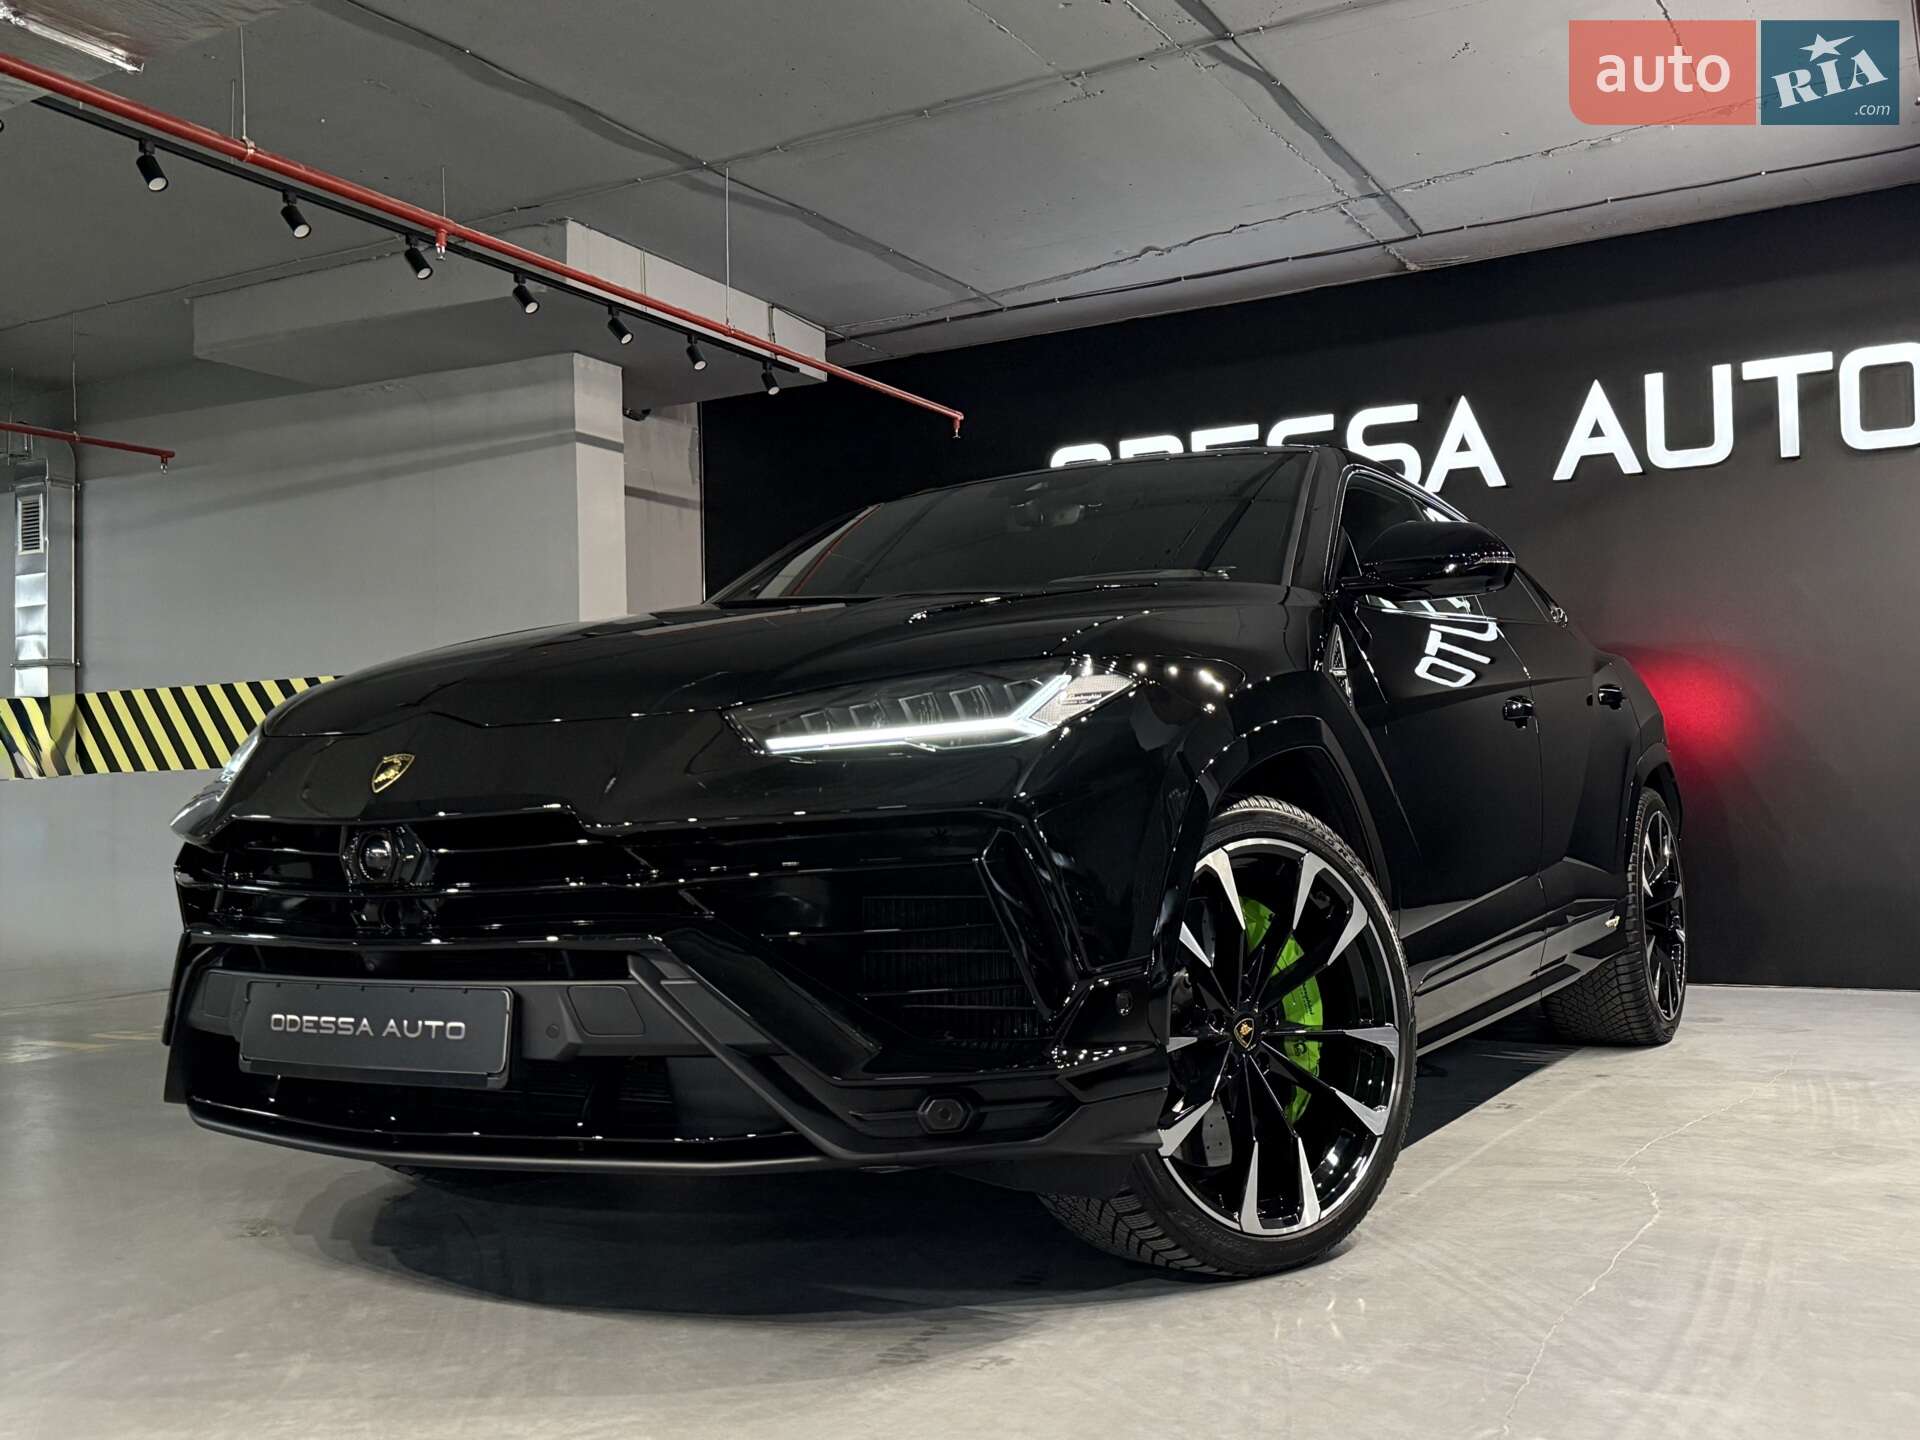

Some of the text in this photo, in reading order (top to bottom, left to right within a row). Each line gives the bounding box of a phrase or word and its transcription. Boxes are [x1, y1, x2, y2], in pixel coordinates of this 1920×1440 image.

[1552, 341, 1920, 482] AUTO
[270, 1013, 466, 1040] ODESSA AUTO
